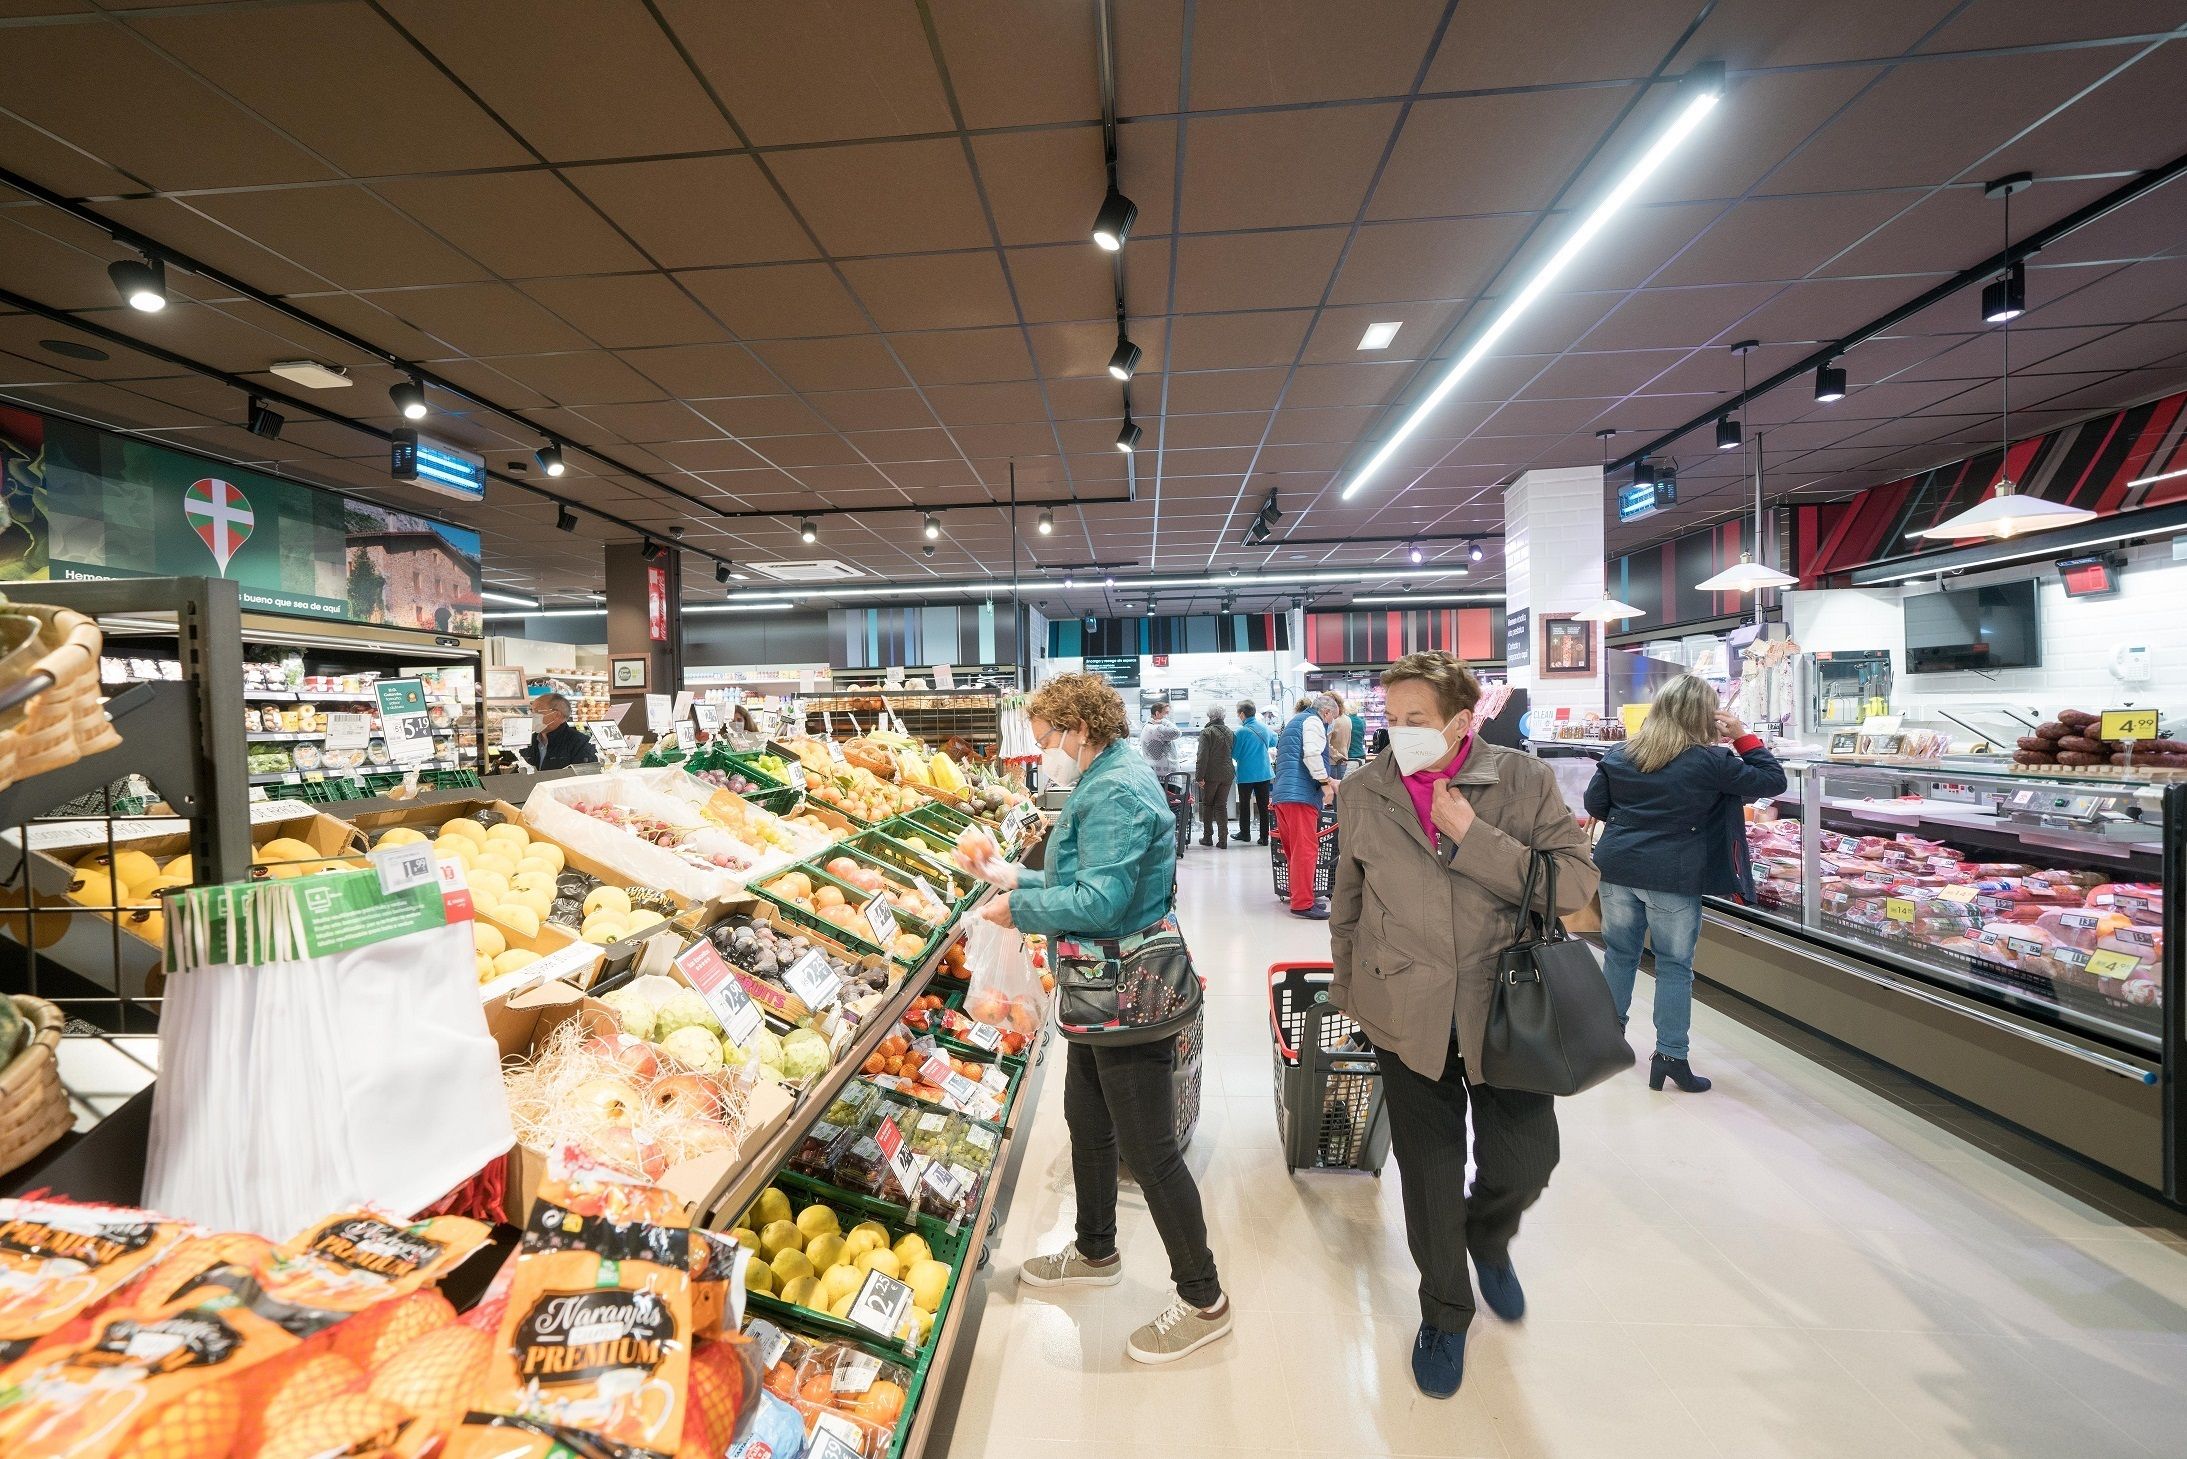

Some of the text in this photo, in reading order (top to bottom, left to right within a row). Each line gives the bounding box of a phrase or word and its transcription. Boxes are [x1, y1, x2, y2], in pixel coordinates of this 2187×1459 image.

[244, 594, 273, 606] bueno
[275, 599, 292, 611] que
[294, 602, 309, 611] sea
[311, 602, 322, 612] de
[323, 603, 341, 614] aquí
[1155, 657, 1167, 665] 34
[1533, 710, 1554, 719] CLEAN
[722, 981, 743, 1013] 2,90
[867, 1275, 895, 1319] 2,25
[534, 1295, 662, 1336] Naranjas
[523, 1338, 662, 1374] PREMIUM
